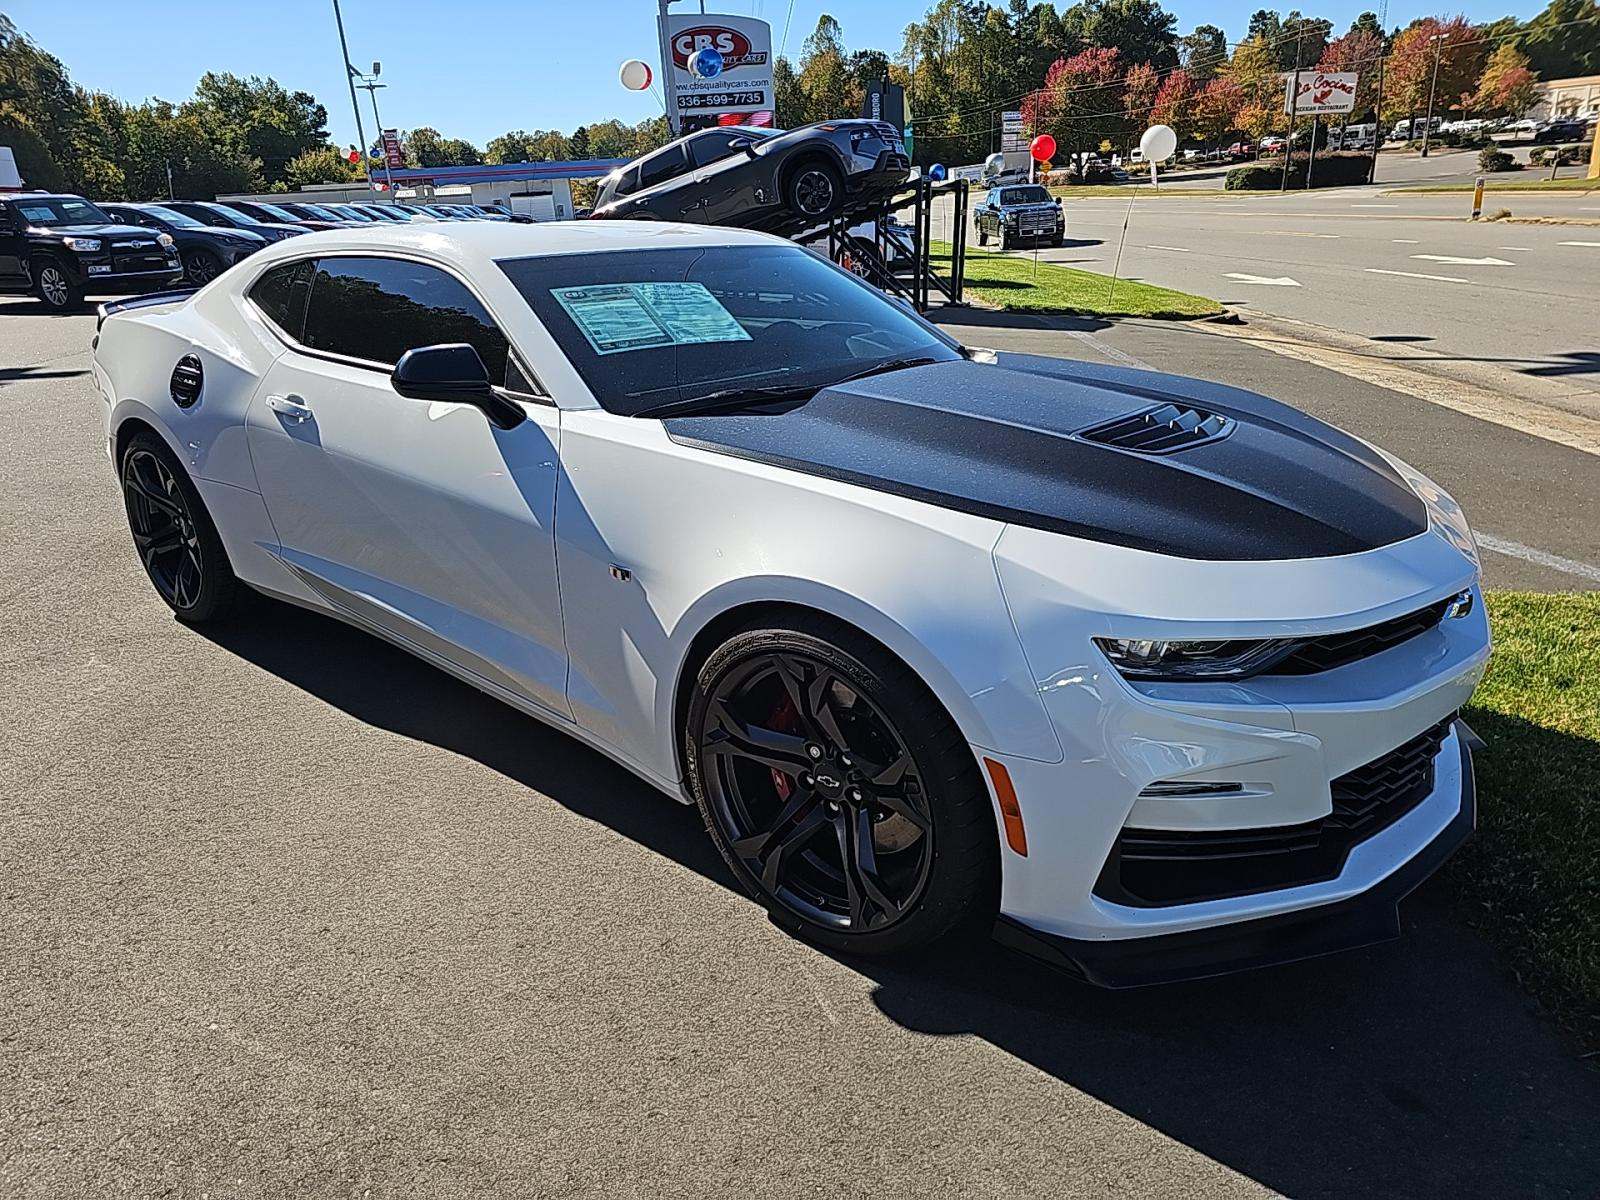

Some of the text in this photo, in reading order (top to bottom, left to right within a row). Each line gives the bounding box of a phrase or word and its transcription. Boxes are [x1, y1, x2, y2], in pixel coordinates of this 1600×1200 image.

[676, 33, 735, 55] CBS
[1314, 75, 1354, 94] Cocina
[679, 92, 761, 107] 336-599-7735
[871, 93, 880, 118] OXBORO
